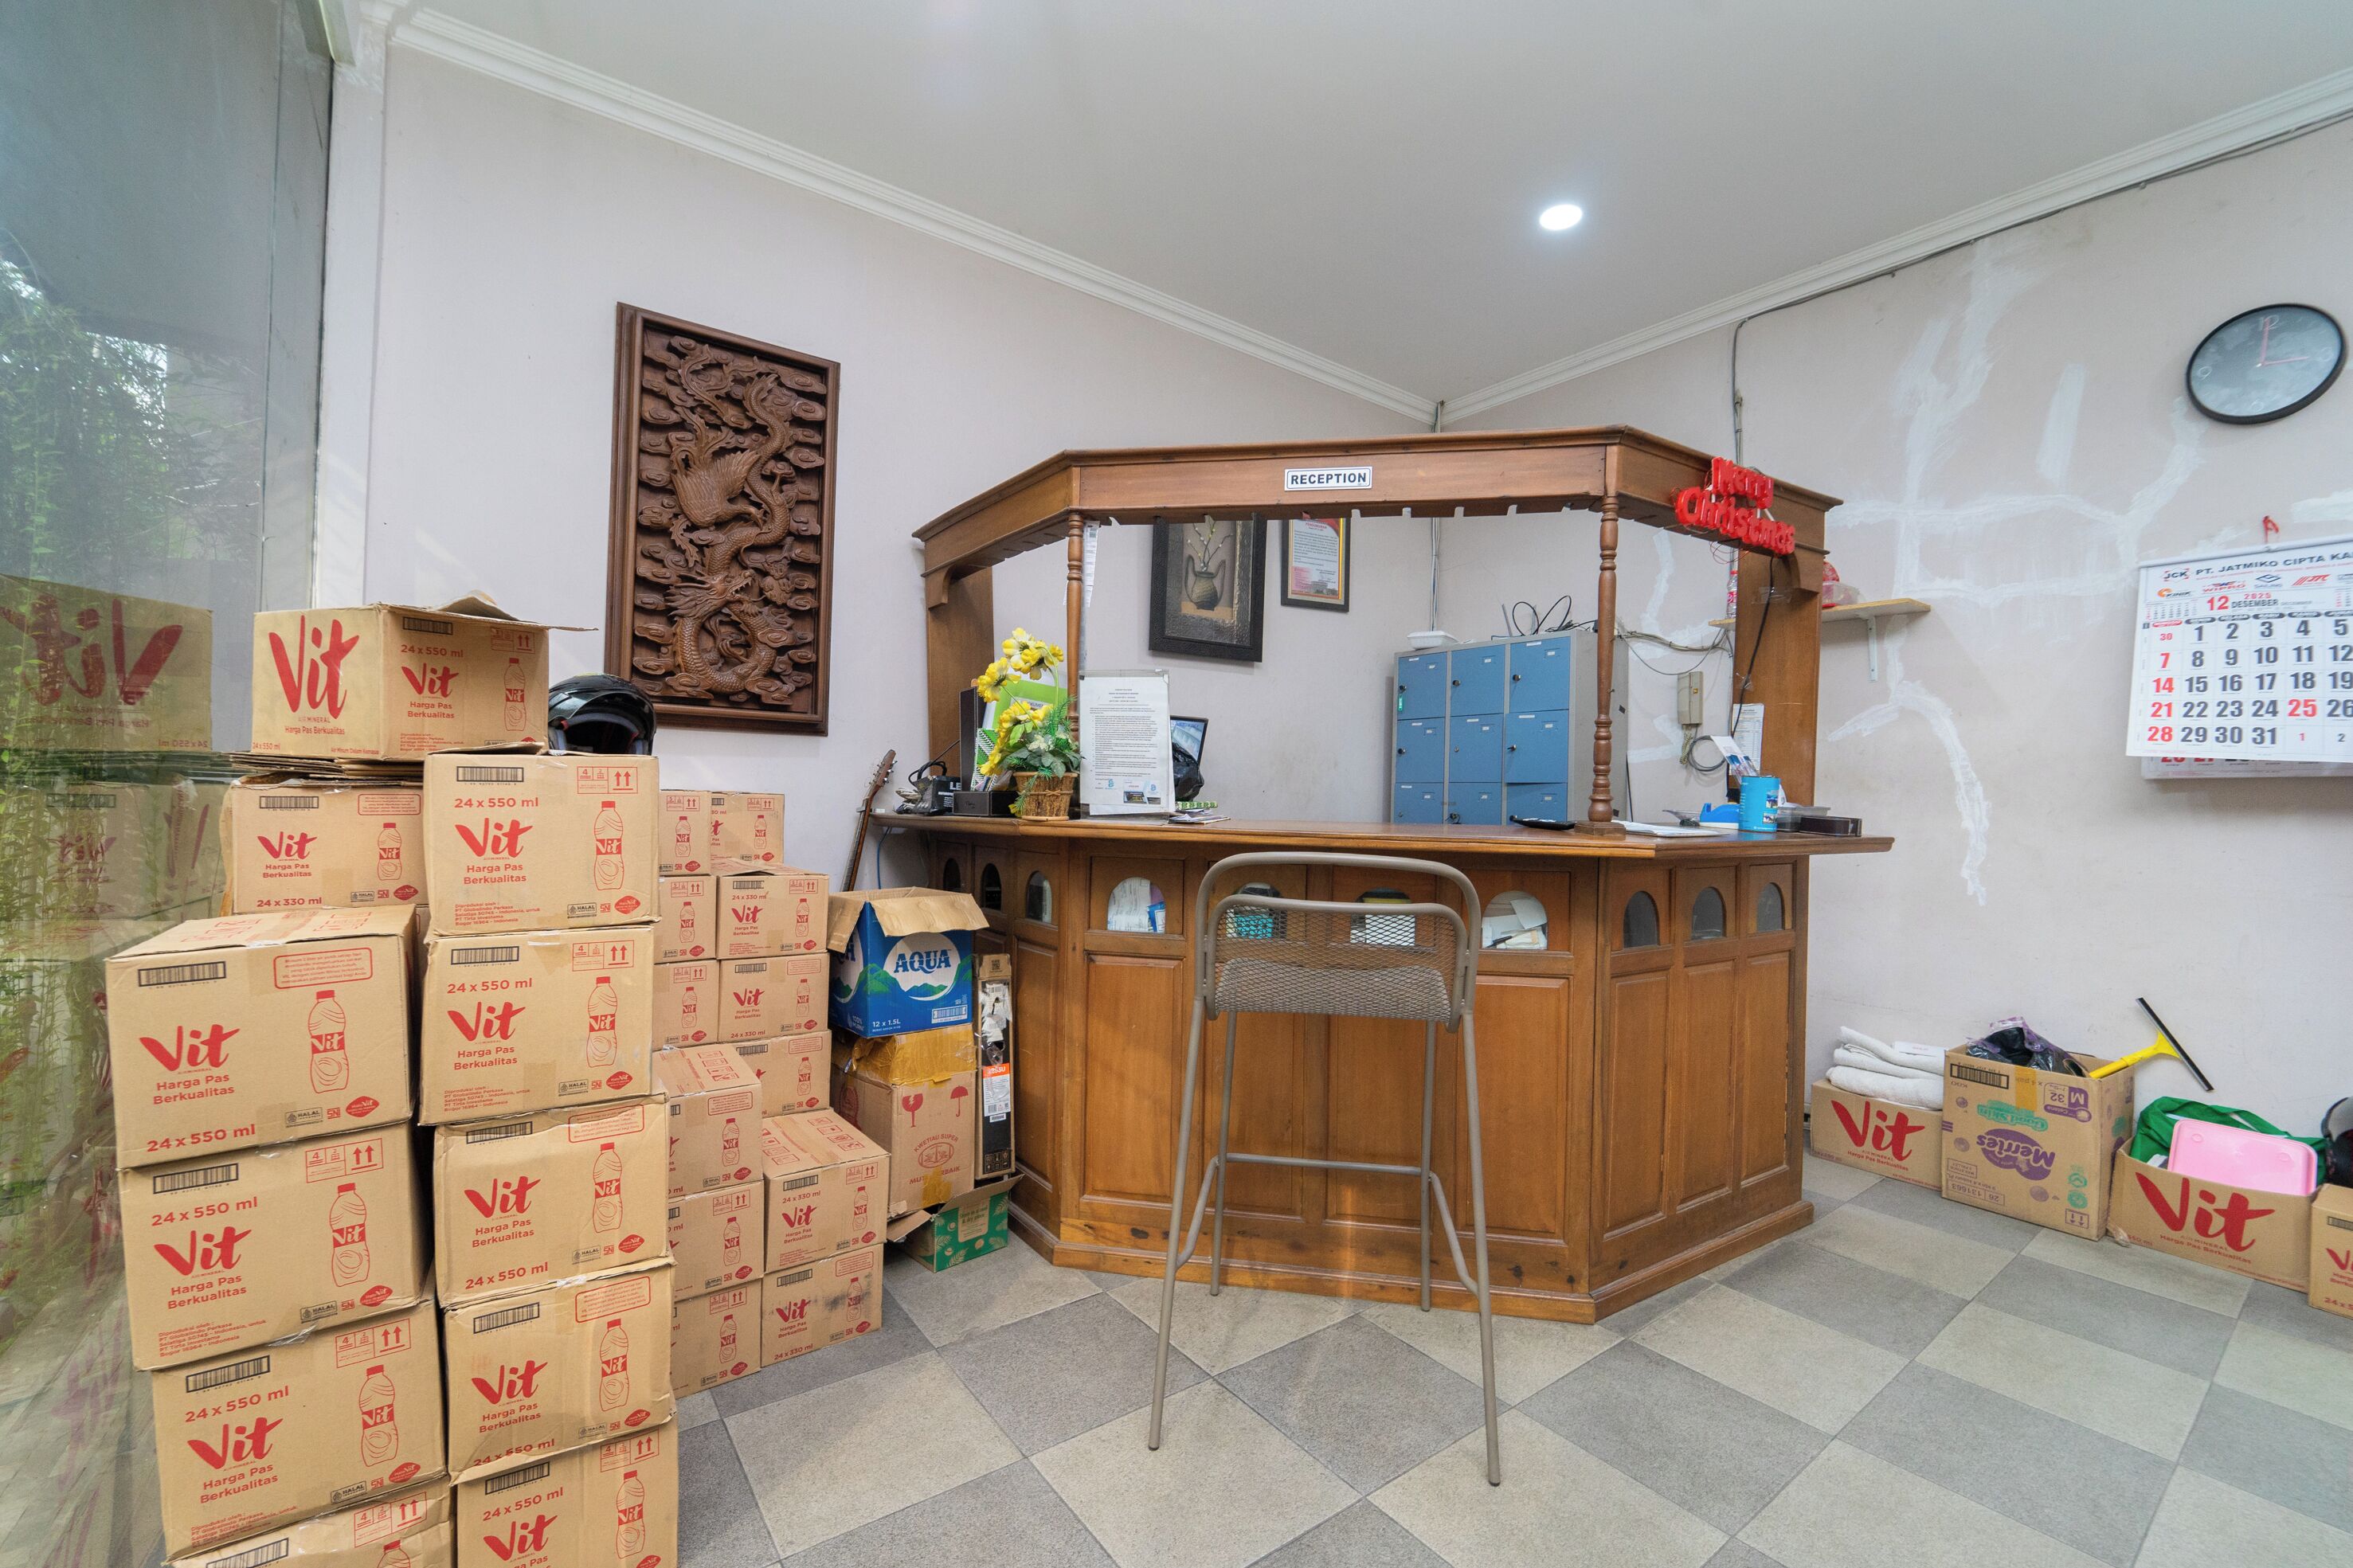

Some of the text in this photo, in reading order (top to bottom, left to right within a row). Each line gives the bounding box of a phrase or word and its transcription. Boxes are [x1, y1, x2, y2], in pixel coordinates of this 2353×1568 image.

[1290, 473, 1367, 484] RECEPTION
[2219, 561, 2277, 572] JATMIKO
[2284, 556, 2324, 565] CIPTA
[2164, 570, 2189, 580] JCK
[2207, 596, 2229, 611] 12
[2232, 599, 2278, 608] DESEMBER
[2195, 626, 2203, 641] 1
[2227, 623, 2238, 639] 2
[2261, 621, 2273, 637] 3
[2296, 620, 2310, 635] 4
[2334, 620, 2347, 635] 5
[422, 647, 447, 656] 550
[2160, 645, 2353, 668] 7 8 9 10 11 12
[268, 616, 359, 719] Vit
[402, 663, 457, 698] Vit
[2152, 671, 2353, 693] 14 15 16 17 18 19
[507, 689, 523, 702] Vit
[410, 701, 434, 710] Harga
[2151, 699, 2353, 718] 21 22 23 24 25 26
[2147, 726, 2173, 742] 28
[2181, 726, 2207, 742] 29
[2214, 726, 2242, 744] 30
[2253, 728, 2277, 745] 31
[454, 798, 473, 808] 24
[487, 797, 516, 807] 550
[521, 797, 539, 807] ml
[258, 832, 315, 859] Vit
[455, 818, 532, 857] Vit
[597, 839, 621, 854] Vit
[381, 848, 400, 859] Vit
[463, 875, 527, 885] Berkualitas
[732, 905, 761, 923] Vit
[895, 949, 951, 973] AQUA
[448, 983, 466, 994] 24
[481, 980, 510, 991] 550
[515, 978, 533, 988] ml
[734, 989, 762, 1007] Vit
[448, 1002, 525, 1042] Vit
[589, 1015, 615, 1030] Vit
[140, 1024, 239, 1071] Vit
[311, 1034, 343, 1053] Vit
[458, 1049, 491, 1058] Harga
[453, 1058, 517, 1070] Berkualitas
[156, 1074, 229, 1091] Harga Pas
[153, 1087, 234, 1105] Berkualitas
[2050, 1093, 2065, 1104] 32
[2071, 1091, 2084, 1104] M
[147, 1138, 172, 1152] 24
[190, 1129, 227, 1144] 550
[233, 1124, 255, 1137] ml
[1832, 1101, 1924, 1161] Vit
[914, 1135, 939, 1152] KWETIAU
[1977, 1135, 2055, 1167] Merries
[1877, 1158, 1909, 1171] Berkualitas
[464, 1176, 539, 1218] Vit
[152, 1197, 257, 1226] 24 x 550 ml
[782, 1206, 815, 1228] Vit
[2135, 1172, 2275, 1252] Vit
[472, 1227, 534, 1247] Berkualitas
[475, 1224, 510, 1236] Harga
[154, 1226, 251, 1276] Vit
[2160, 1234, 2251, 1264] Harga Pas Berkualitas
[170, 1275, 241, 1296] Harga Pas
[167, 1283, 247, 1309] Berkualitas
[777, 1300, 808, 1322] Vit
[472, 1360, 547, 1405] Vit
[480, 1409, 541, 1433] Berkualitas
[483, 1403, 538, 1422] Harga Pas
[188, 1417, 284, 1469] Vit
[203, 1464, 272, 1489] Harga Pas
[200, 1473, 278, 1503] Berkualitas
[484, 1515, 558, 1561] Vit
